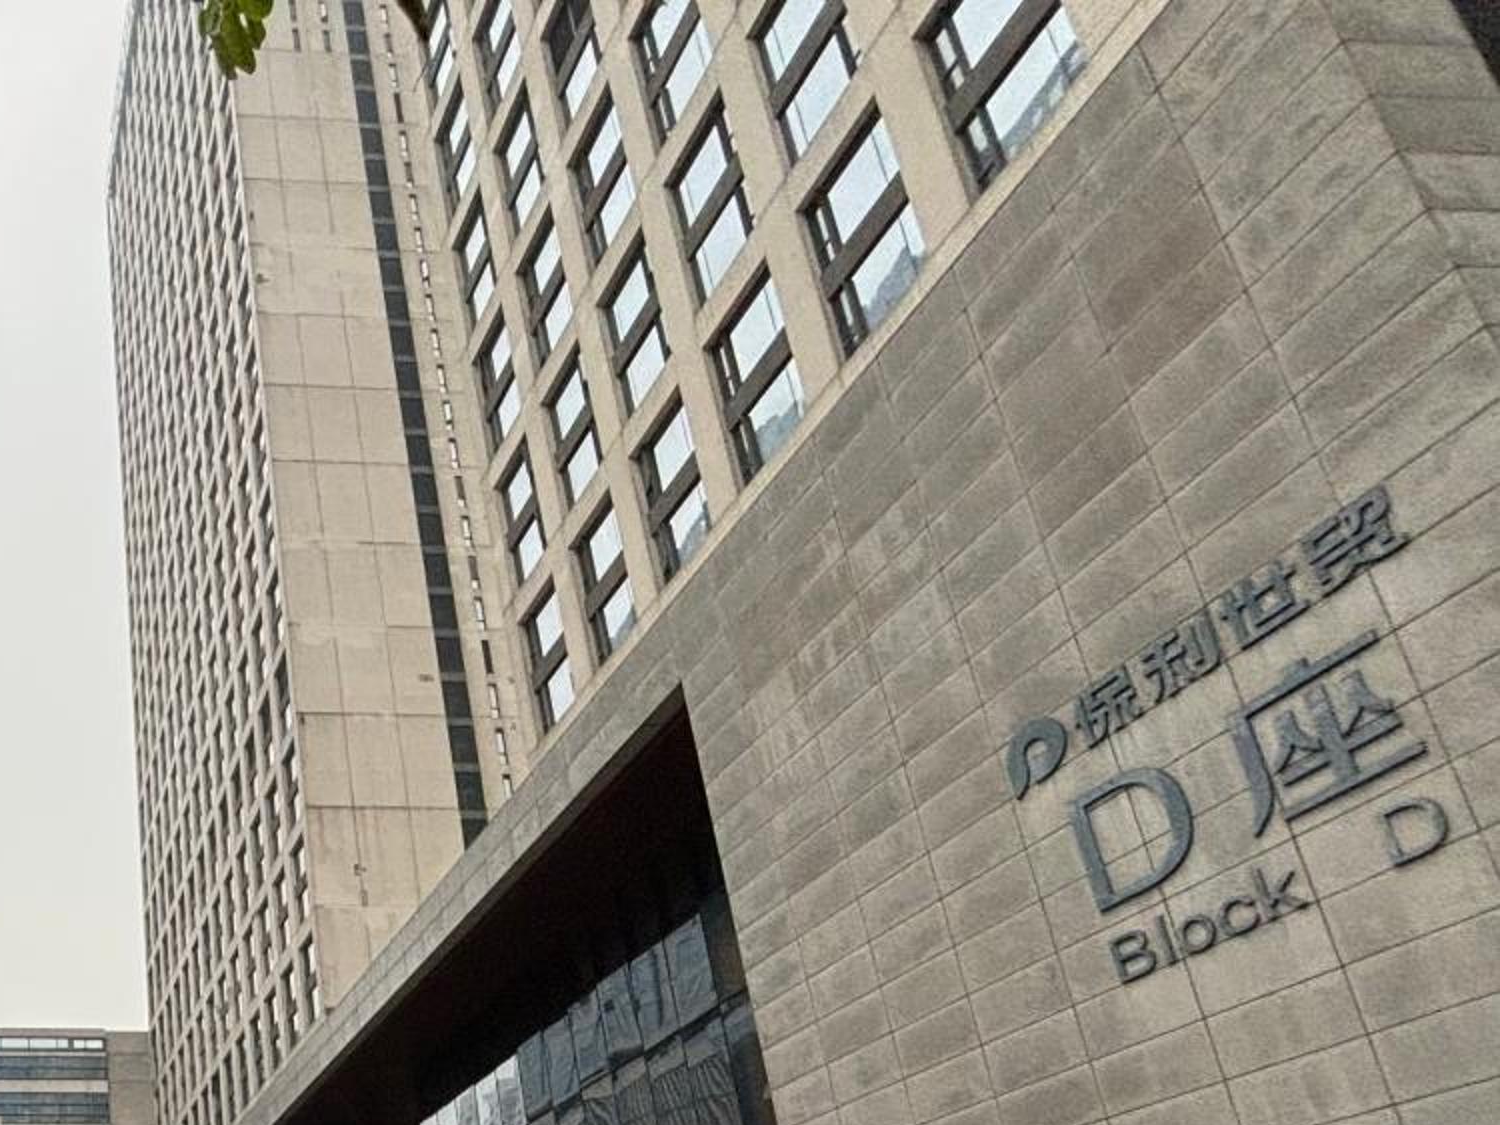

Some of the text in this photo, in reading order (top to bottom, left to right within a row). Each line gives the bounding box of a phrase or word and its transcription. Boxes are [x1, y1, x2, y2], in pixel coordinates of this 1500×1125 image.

[1075, 484, 1411, 750] 保利世贸
[1072, 629, 1428, 914] D座
[1109, 798, 1449, 985] Block D
